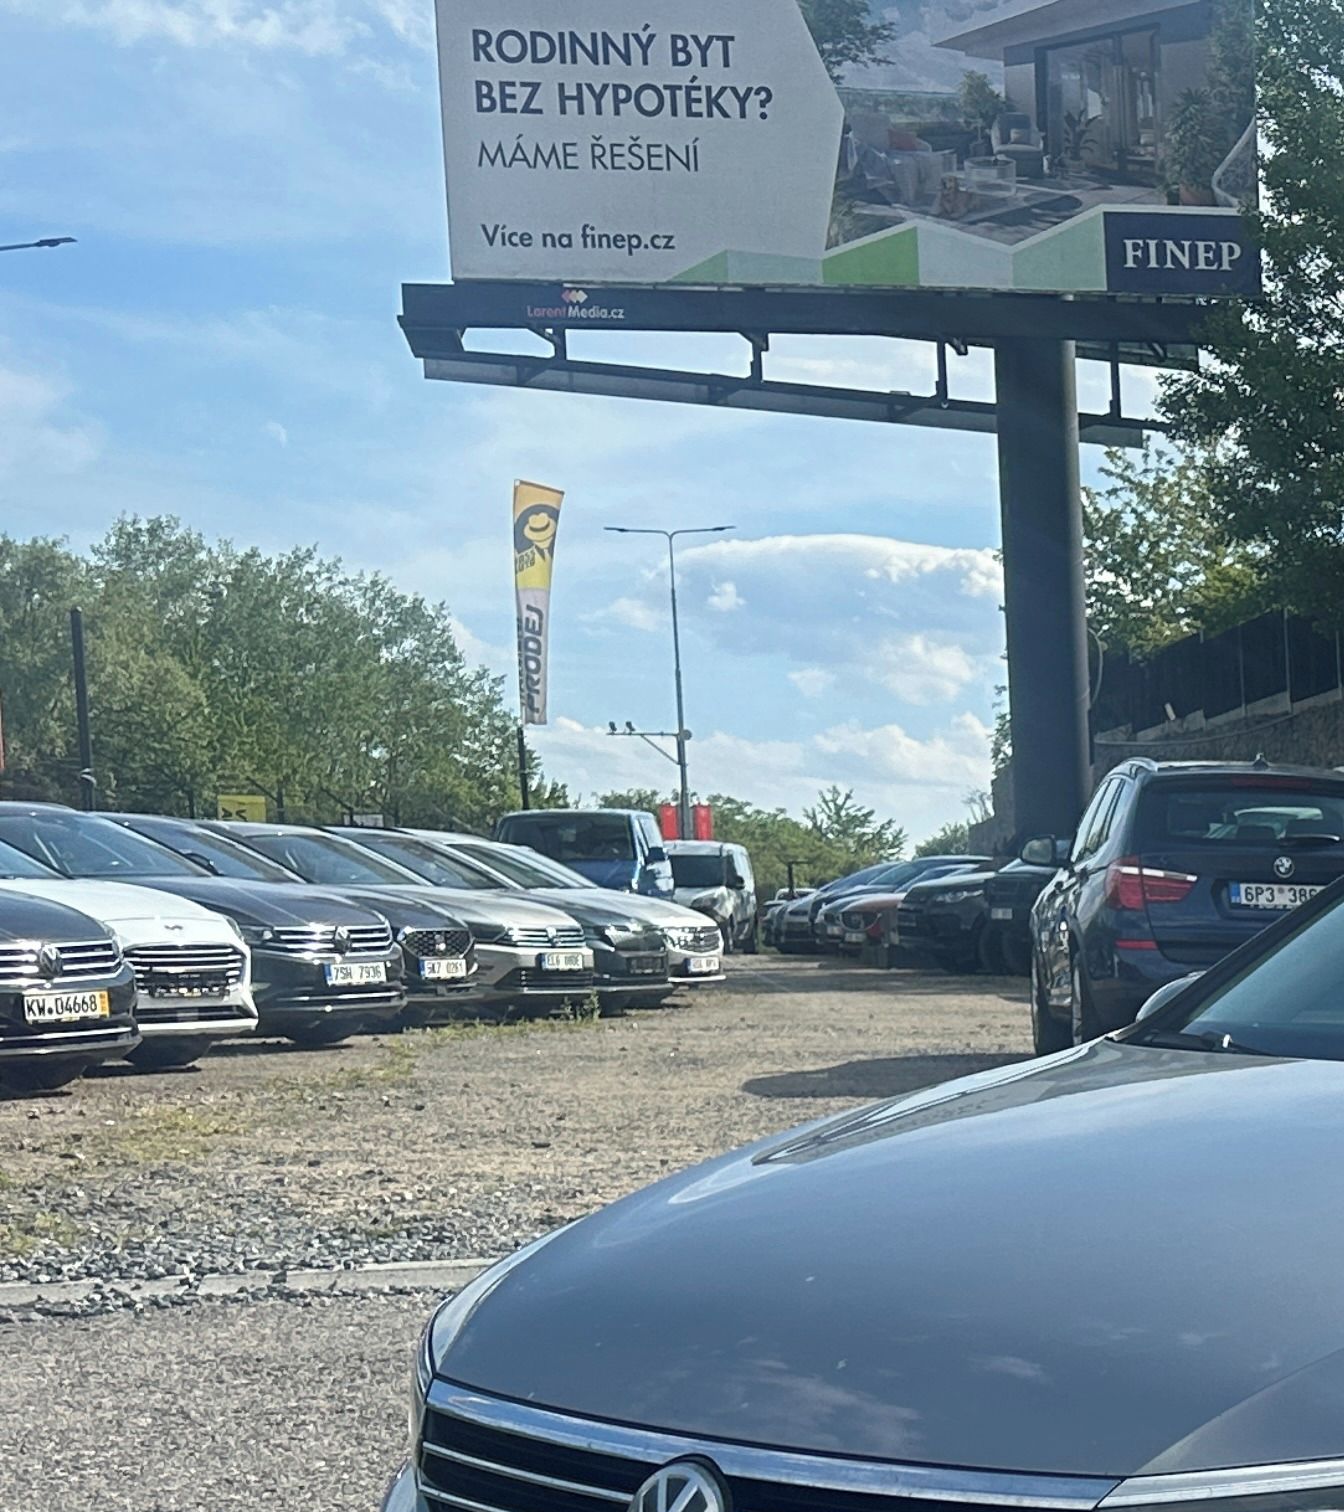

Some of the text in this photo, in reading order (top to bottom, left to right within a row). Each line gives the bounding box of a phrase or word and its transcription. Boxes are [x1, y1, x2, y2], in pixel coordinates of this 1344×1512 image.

[472, 23, 735, 68] RODINNÝ BYT
[475, 75, 773, 120] BEZ HYPOTÉKY?
[477, 133, 700, 172] MÁME ŘEŠENÍ
[481, 223, 675, 256] Více na finep.cz
[1123, 239, 1241, 271] FINEP
[524, 603, 544, 714] PRODEJ
[1244, 886, 1275, 903] 6P3
